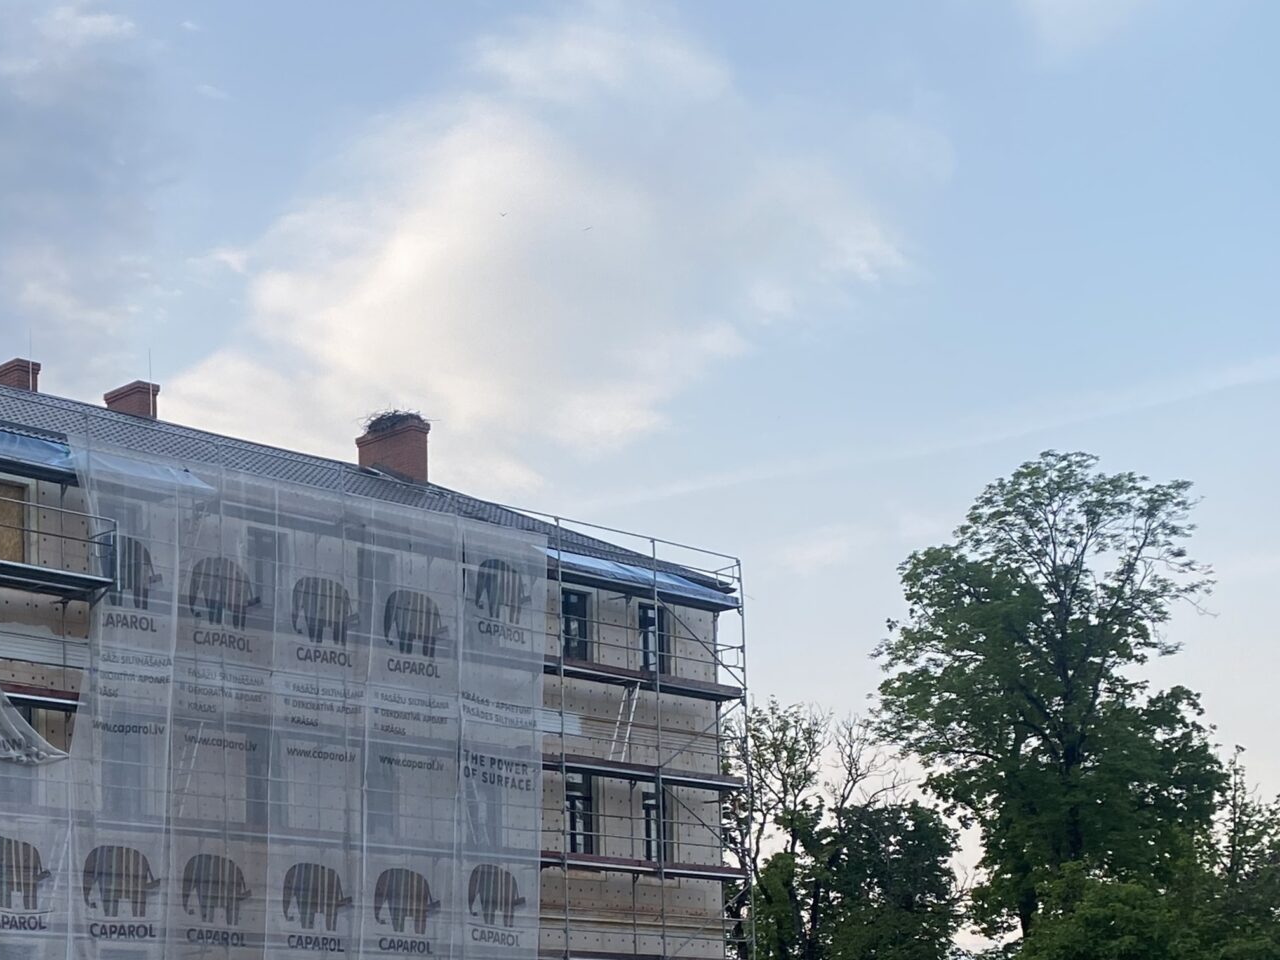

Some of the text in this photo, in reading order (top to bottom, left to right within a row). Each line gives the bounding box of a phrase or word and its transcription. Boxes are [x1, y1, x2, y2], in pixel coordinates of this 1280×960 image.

[103, 612, 157, 633] APAROL
[193, 630, 253, 653] CAPAROL
[478, 621, 526, 644] CAPAROL
[297, 647, 352, 668] CAPAROL
[387, 658, 440, 678] CAPAROL
[463, 750, 528, 775] THE POWER
[464, 766, 478, 779] OF
[90, 923, 156, 939] CAPAROL
[187, 928, 246, 947] CAPAROL
[471, 928, 520, 947] CAPAROL
[288, 935, 344, 952] CAPAROL
[379, 937, 433, 954] CAPAROL
